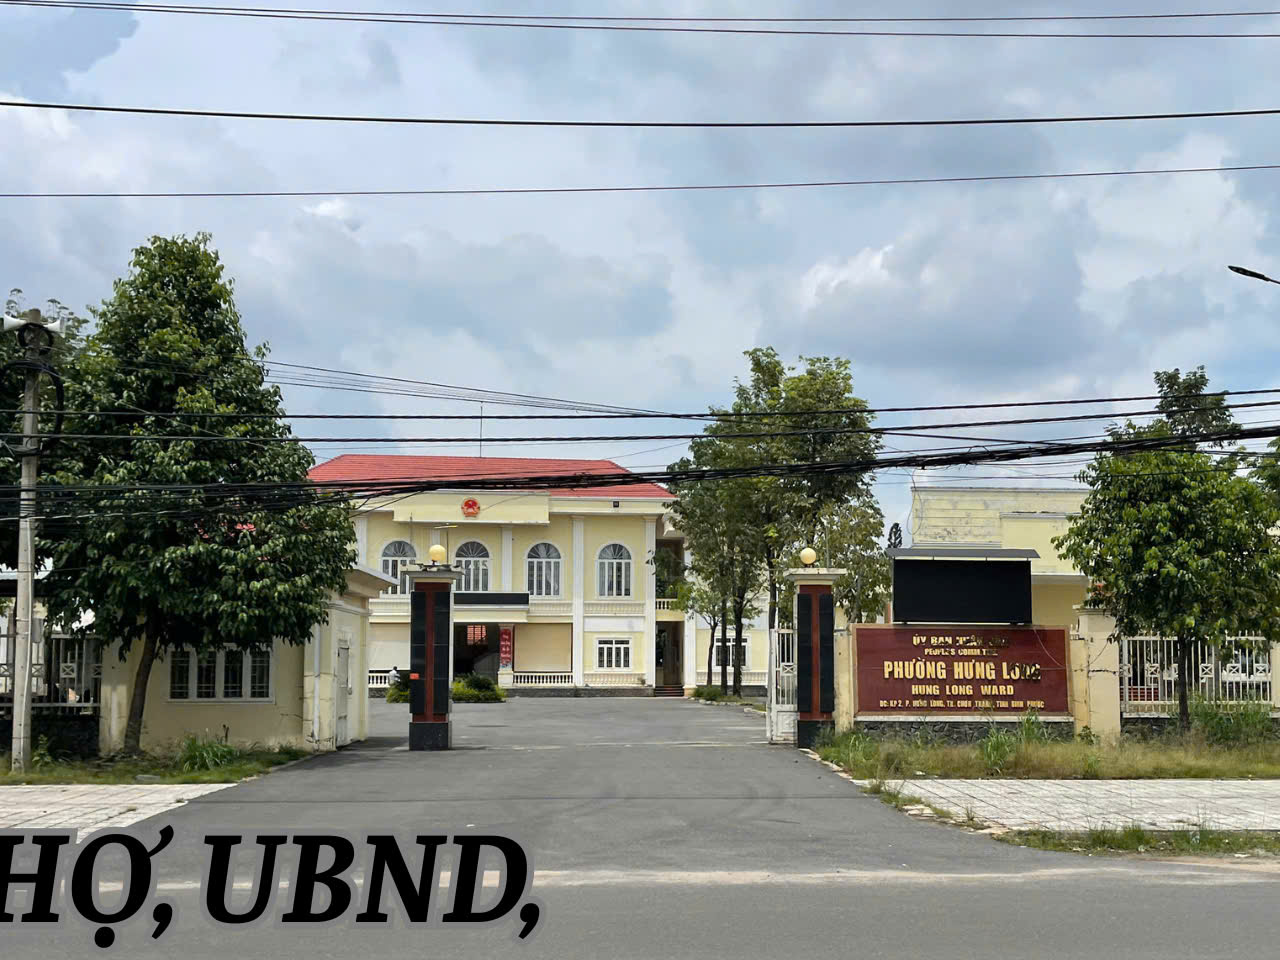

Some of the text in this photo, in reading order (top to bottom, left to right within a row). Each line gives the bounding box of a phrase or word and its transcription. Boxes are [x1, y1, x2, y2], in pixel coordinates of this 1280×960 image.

[931, 637, 952, 645] BAN
[883, 657, 946, 679] PHƯỜNG
[954, 659, 996, 679] HƯNG
[912, 685, 1014, 695] HUNG LONG WARD
